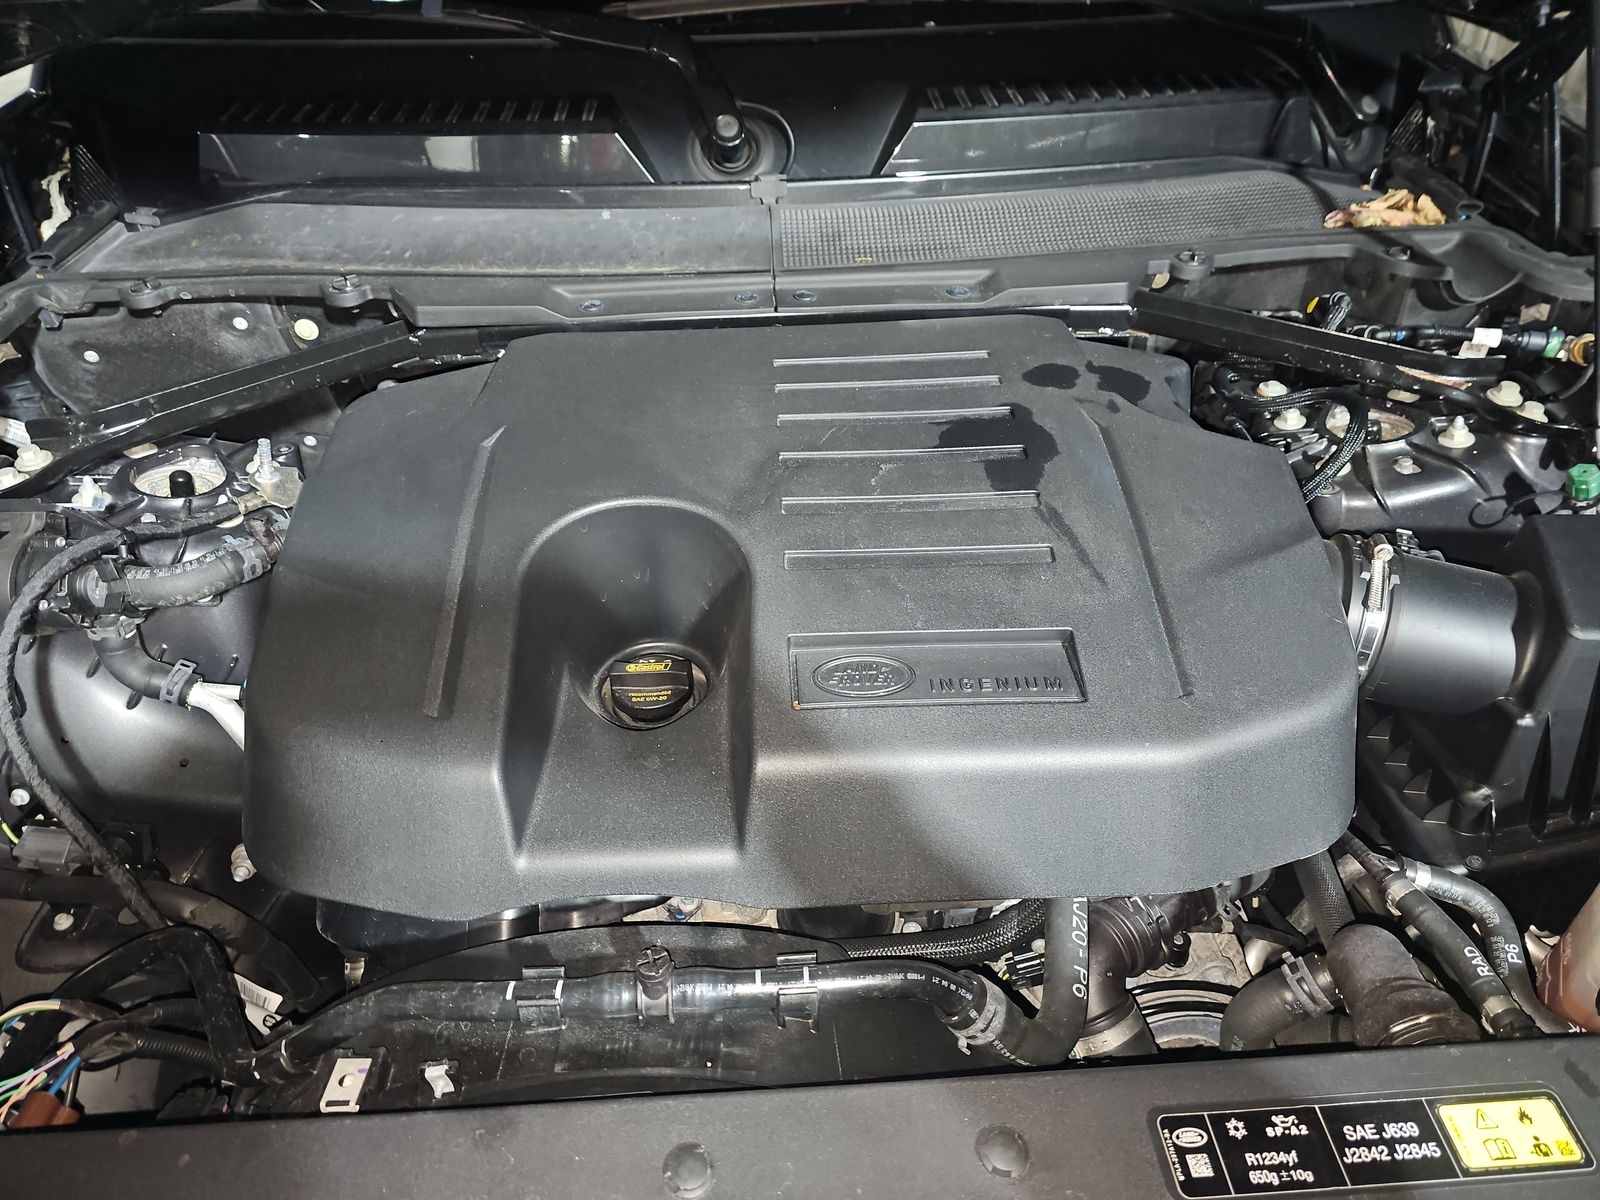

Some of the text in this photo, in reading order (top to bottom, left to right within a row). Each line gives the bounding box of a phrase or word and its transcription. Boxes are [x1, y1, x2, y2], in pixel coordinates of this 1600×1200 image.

[929, 676, 1065, 693] INGENIUM
[1463, 946, 1494, 978] RAD
[1504, 943, 1523, 964] P6
[1265, 1124, 1310, 1138] SP-A2
[1342, 1121, 1420, 1141] SAE J639
[1244, 1149, 1299, 1168] R1234yf
[1342, 1141, 1442, 1164] J2842 J2845
